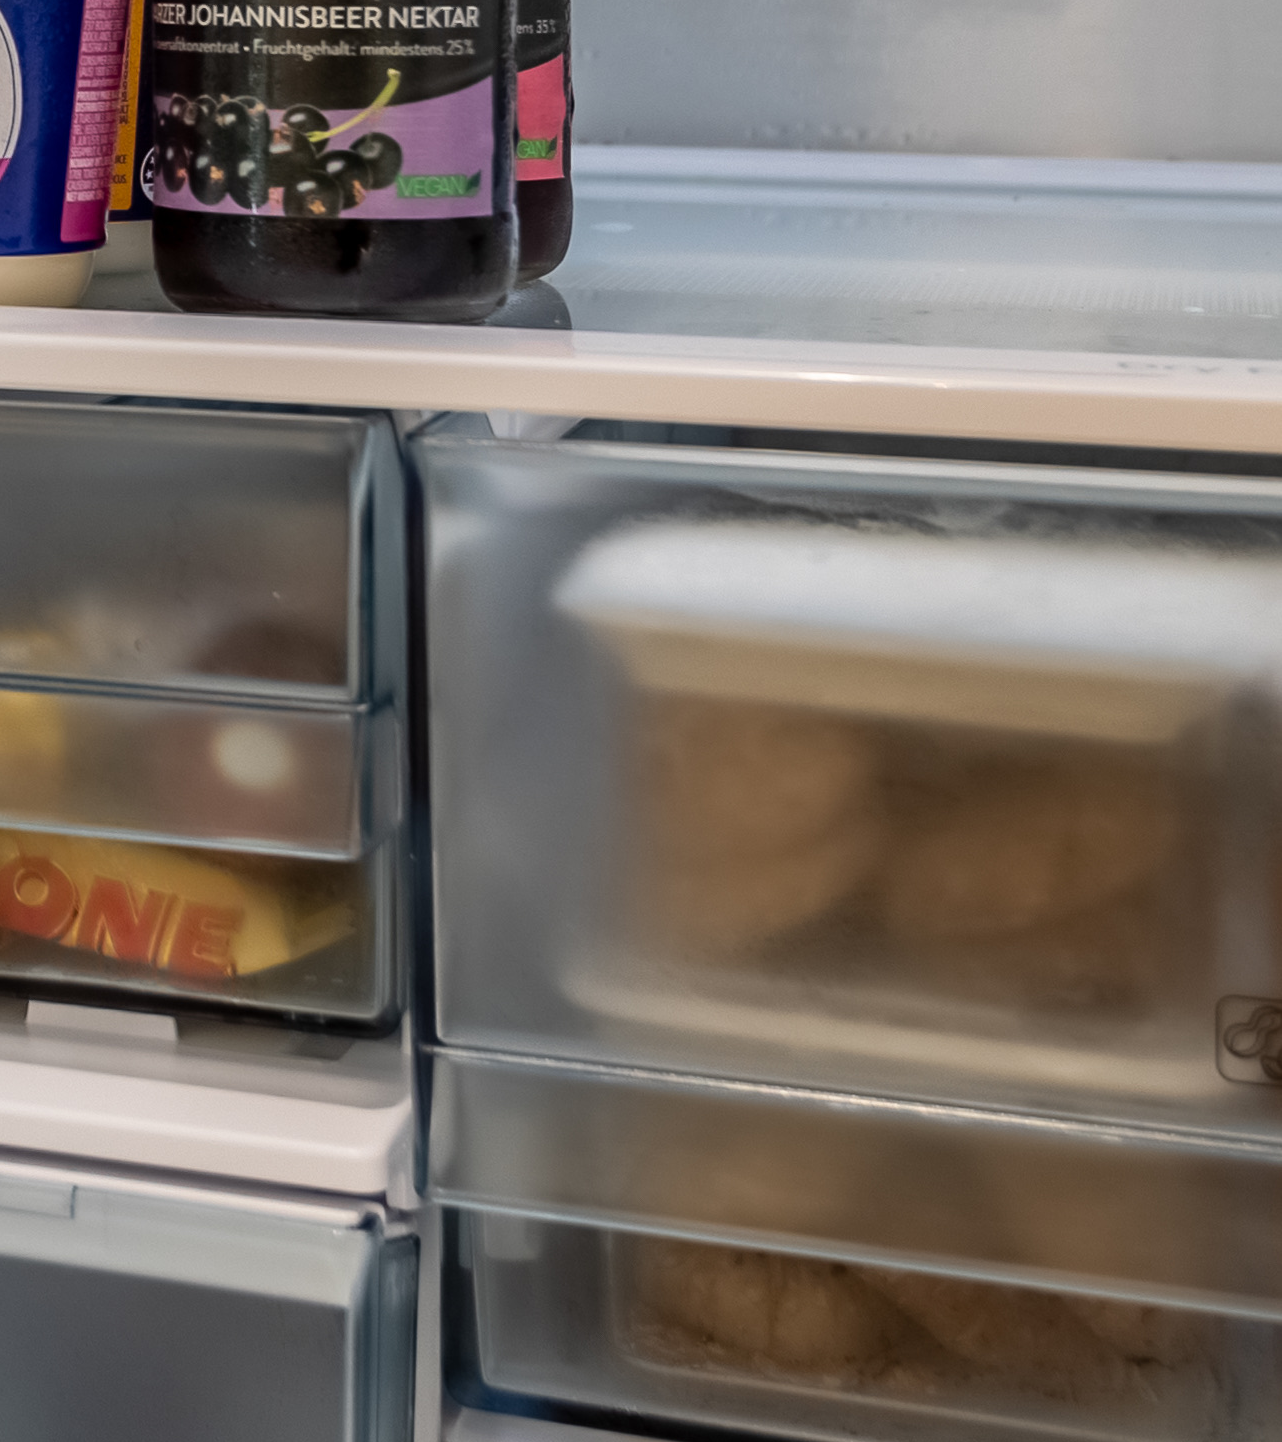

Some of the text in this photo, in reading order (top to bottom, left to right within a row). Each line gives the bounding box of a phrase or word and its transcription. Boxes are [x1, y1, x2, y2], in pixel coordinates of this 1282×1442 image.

[187, 4, 480, 29] JOHANNISBEER NEKTAR
[535, 18, 557, 35] 35%
[252, 37, 475, 62] Fruchtgehalt: mindestens 25%
[396, 175, 468, 197] VEGAN
